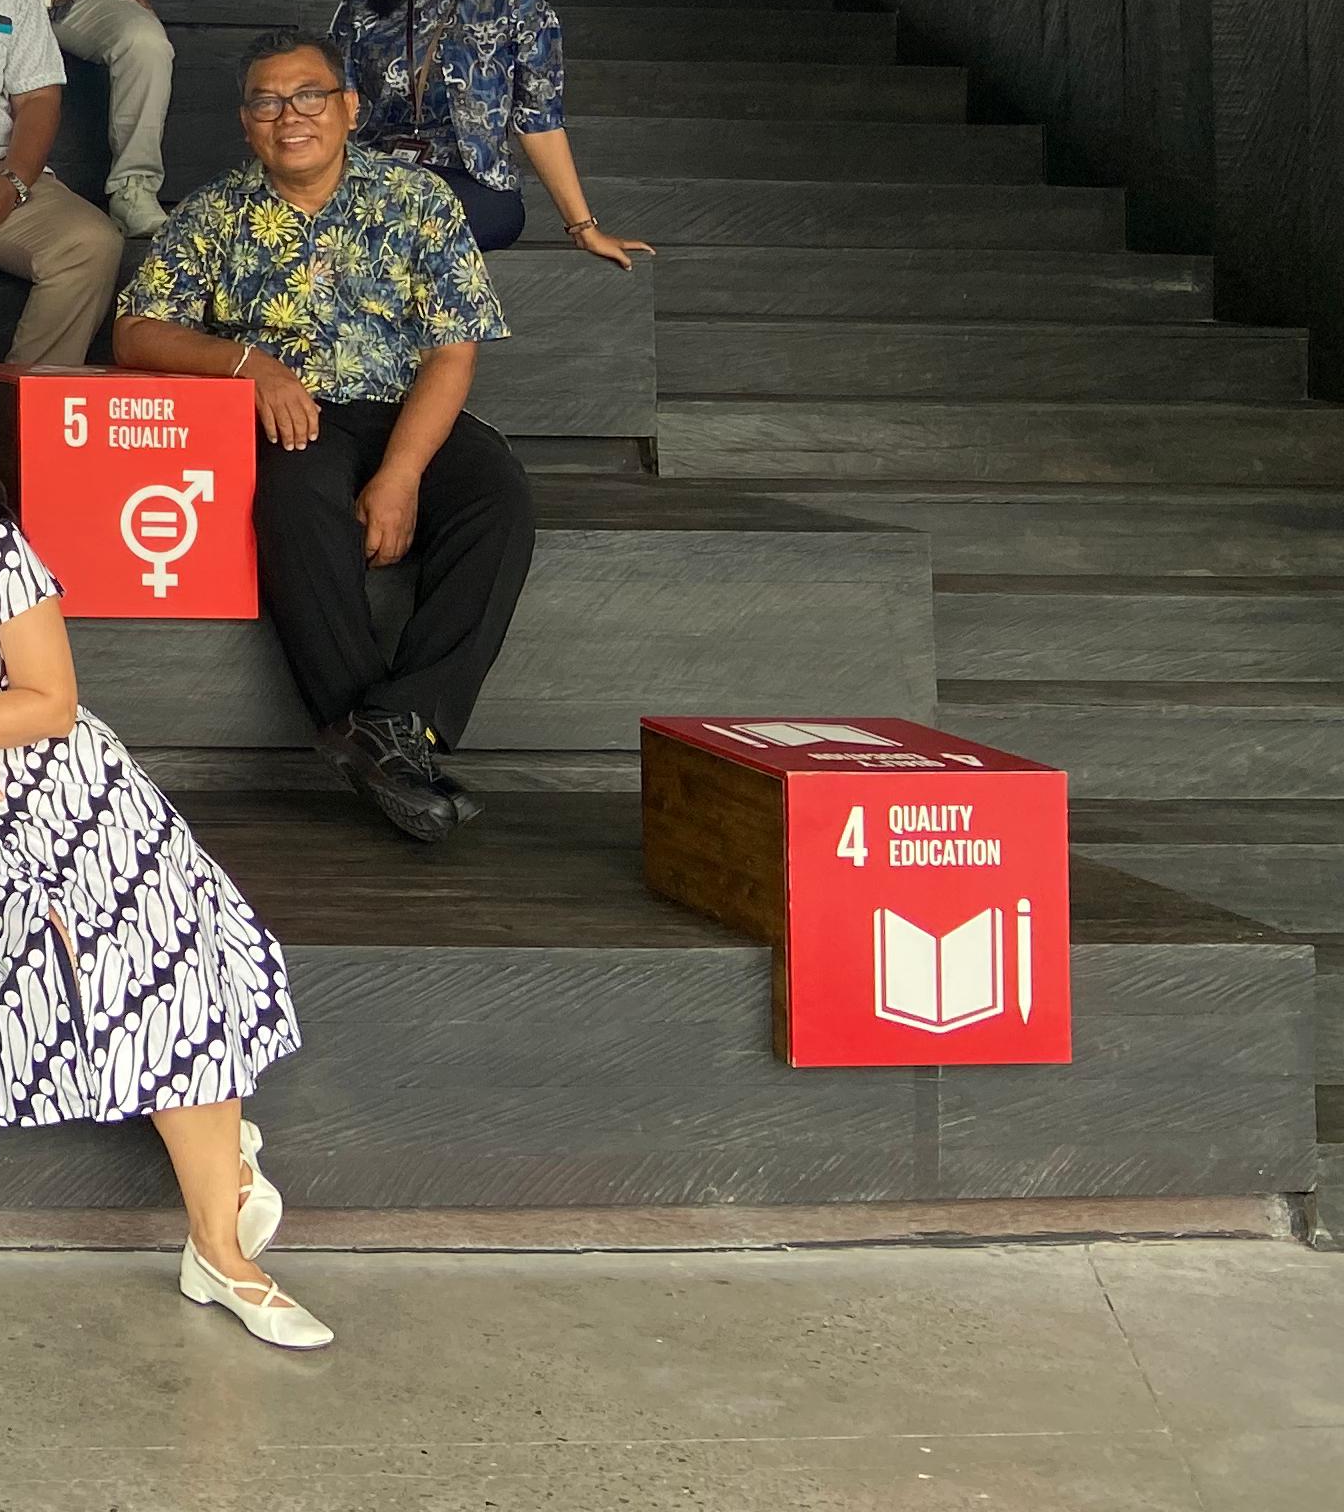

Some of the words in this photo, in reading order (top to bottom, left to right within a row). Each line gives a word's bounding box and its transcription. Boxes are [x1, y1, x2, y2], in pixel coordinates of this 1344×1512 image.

[63, 397, 88, 448] 5
[108, 397, 175, 421] GENDER
[108, 425, 189, 450] EQUALITY
[940, 753, 984, 767] 4
[836, 805, 869, 867] 4
[888, 804, 973, 835] QUALITY
[889, 839, 1001, 867] EDUCATION
